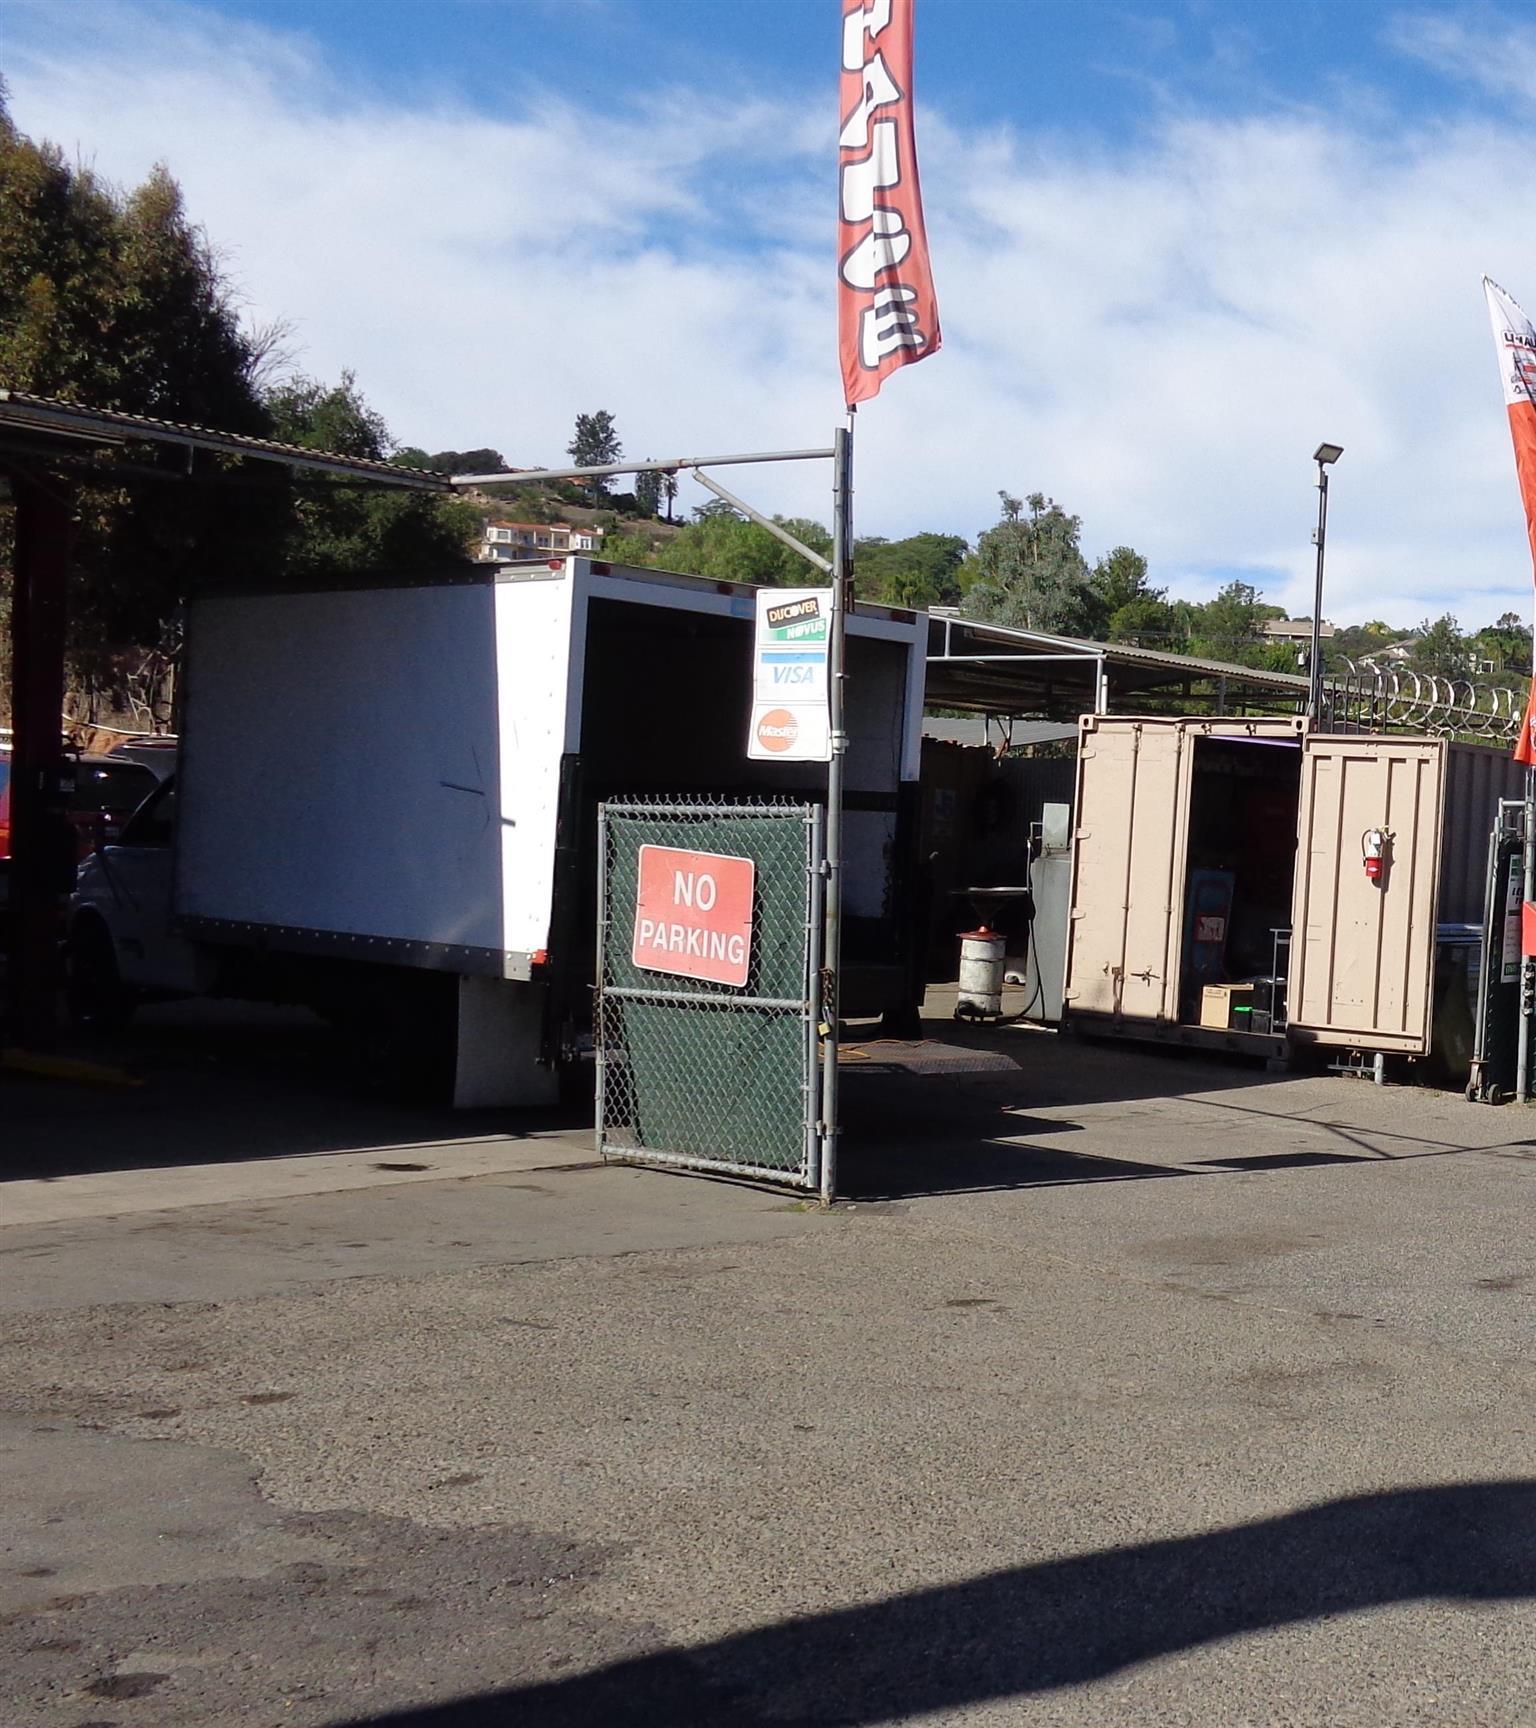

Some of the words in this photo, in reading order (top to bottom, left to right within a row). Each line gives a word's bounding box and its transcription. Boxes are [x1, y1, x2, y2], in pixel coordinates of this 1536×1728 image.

[768, 601, 818, 623] DISCOVER
[786, 620, 826, 640] NOVUS
[772, 666, 815, 684] VISA
[674, 870, 716, 912] NO
[639, 920, 745, 965] PARKING
